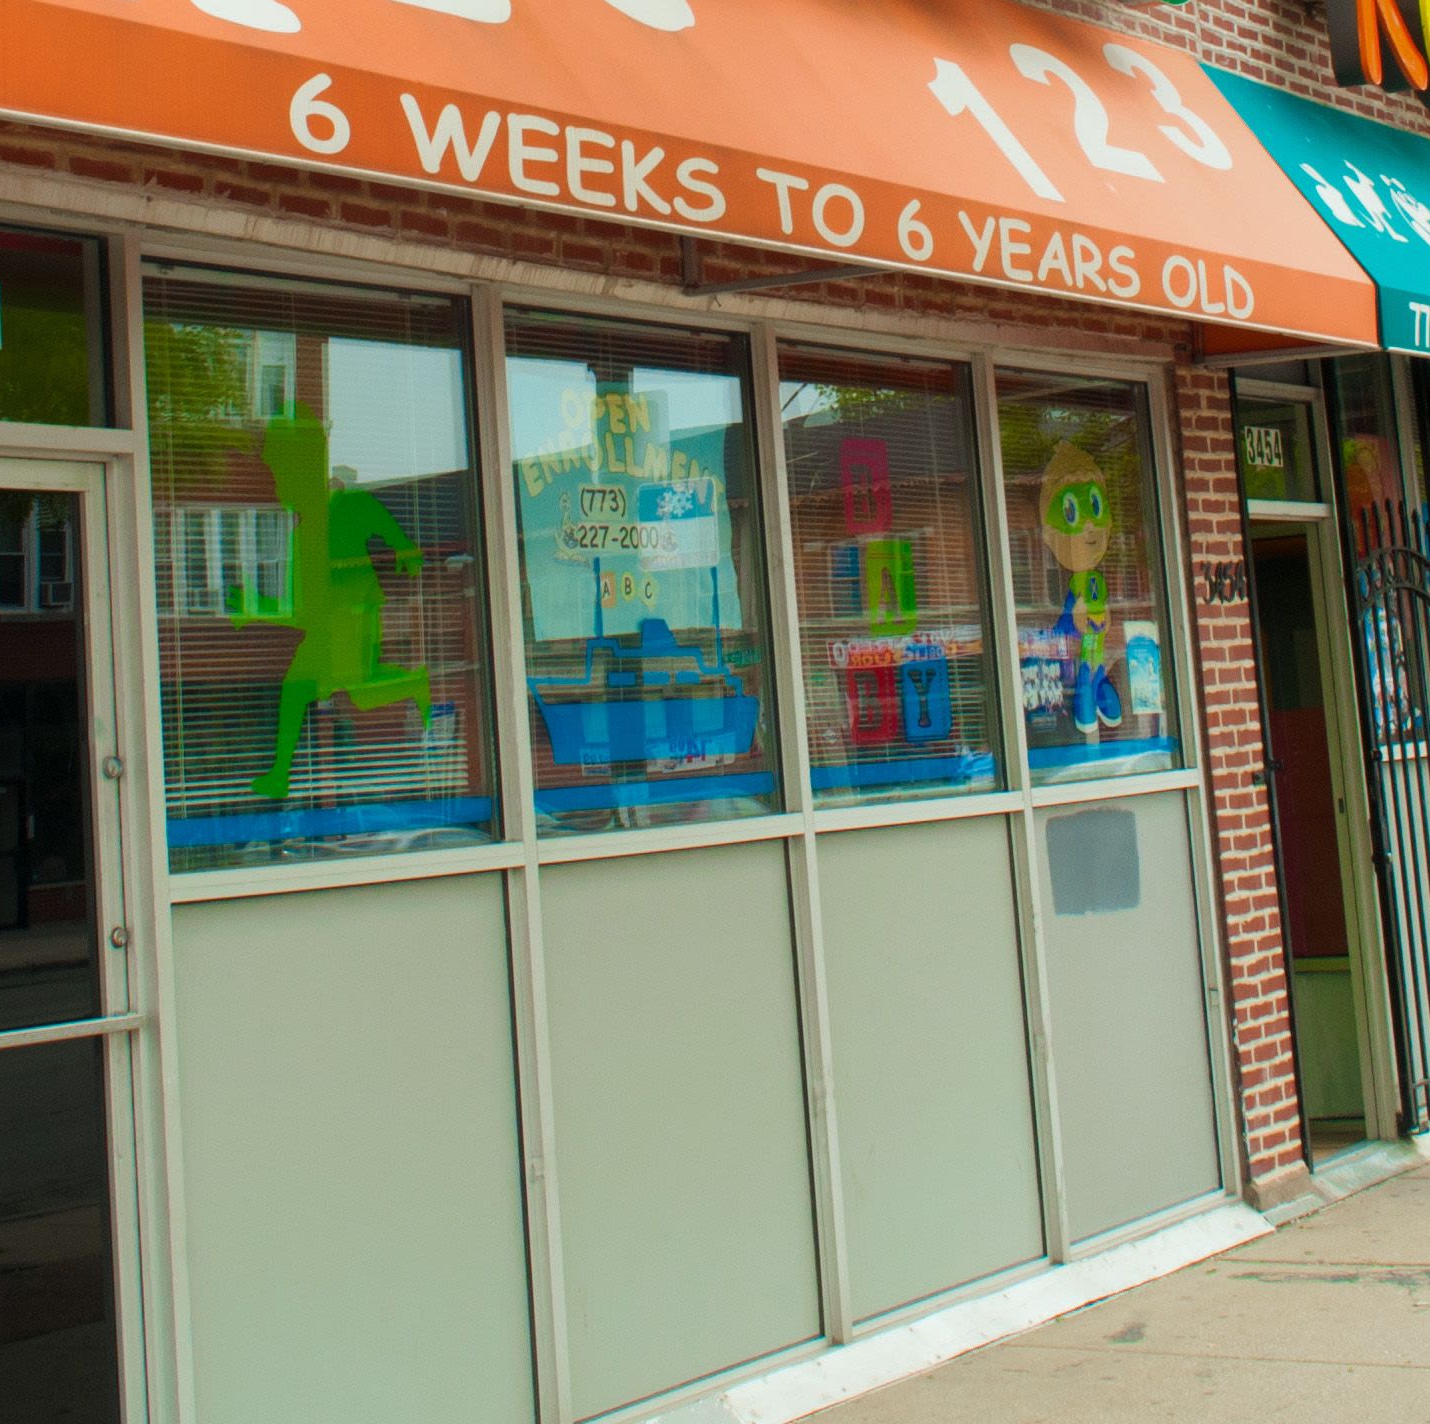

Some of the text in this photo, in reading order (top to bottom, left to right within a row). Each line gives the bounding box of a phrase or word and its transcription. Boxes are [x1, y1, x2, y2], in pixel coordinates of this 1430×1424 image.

[289, 73, 1254, 319] 6 WEEKS TO 6 YEARS OLD
[561, 389, 651, 434] OPEN
[1246, 427, 1282, 466] 3454
[522, 431, 725, 513] ENROLLMENT
[580, 488, 626, 517] (773)
[579, 525, 659, 549] 227-2000
